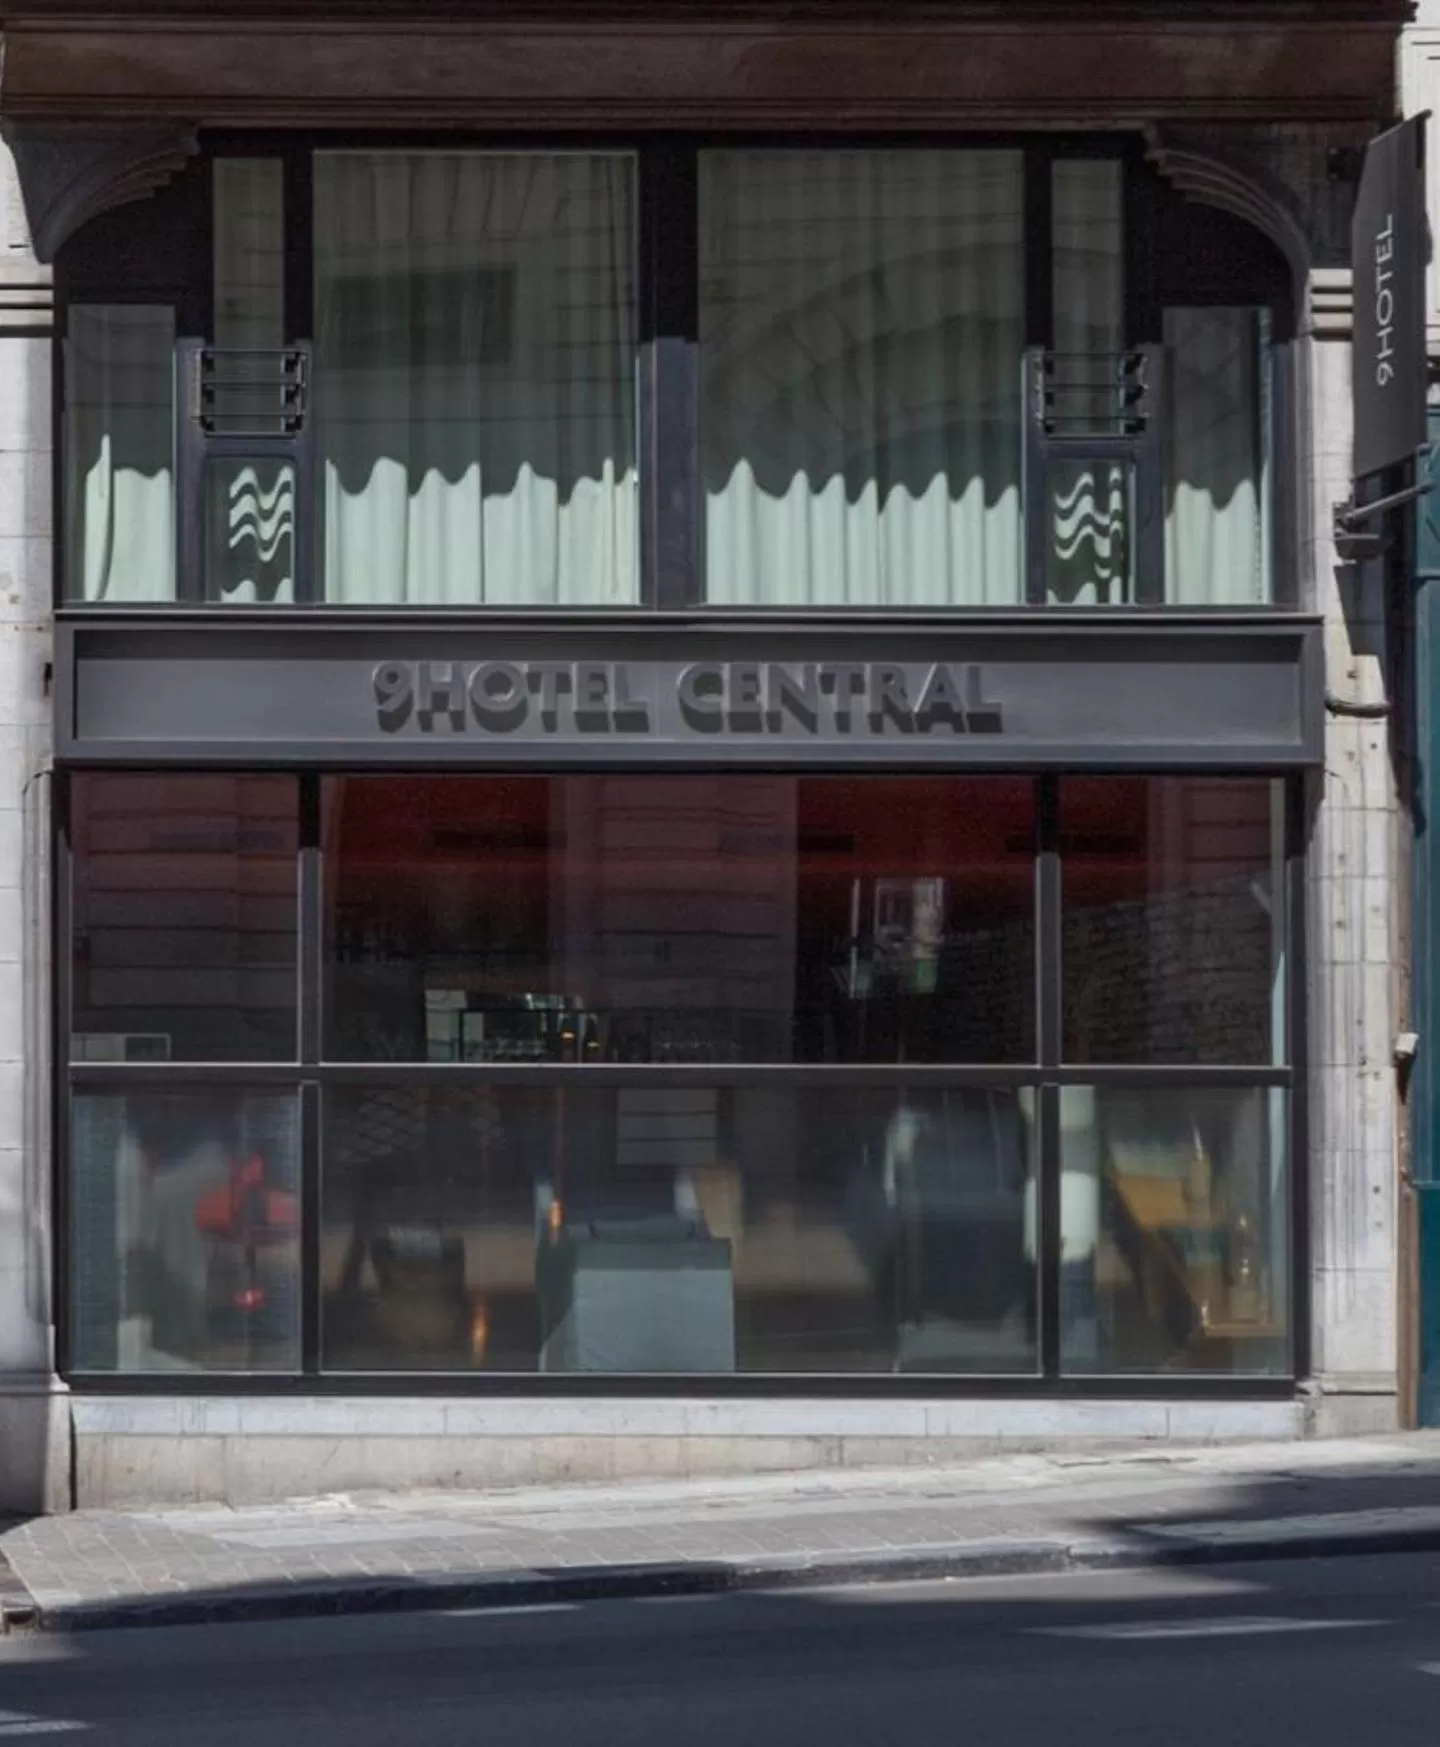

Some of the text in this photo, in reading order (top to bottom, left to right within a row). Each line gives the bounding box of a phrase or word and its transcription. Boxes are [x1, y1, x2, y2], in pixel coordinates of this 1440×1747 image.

[1375, 214, 1394, 386] 9HOTEL
[371, 660, 1003, 714] 9HOTEL CENTRAL
